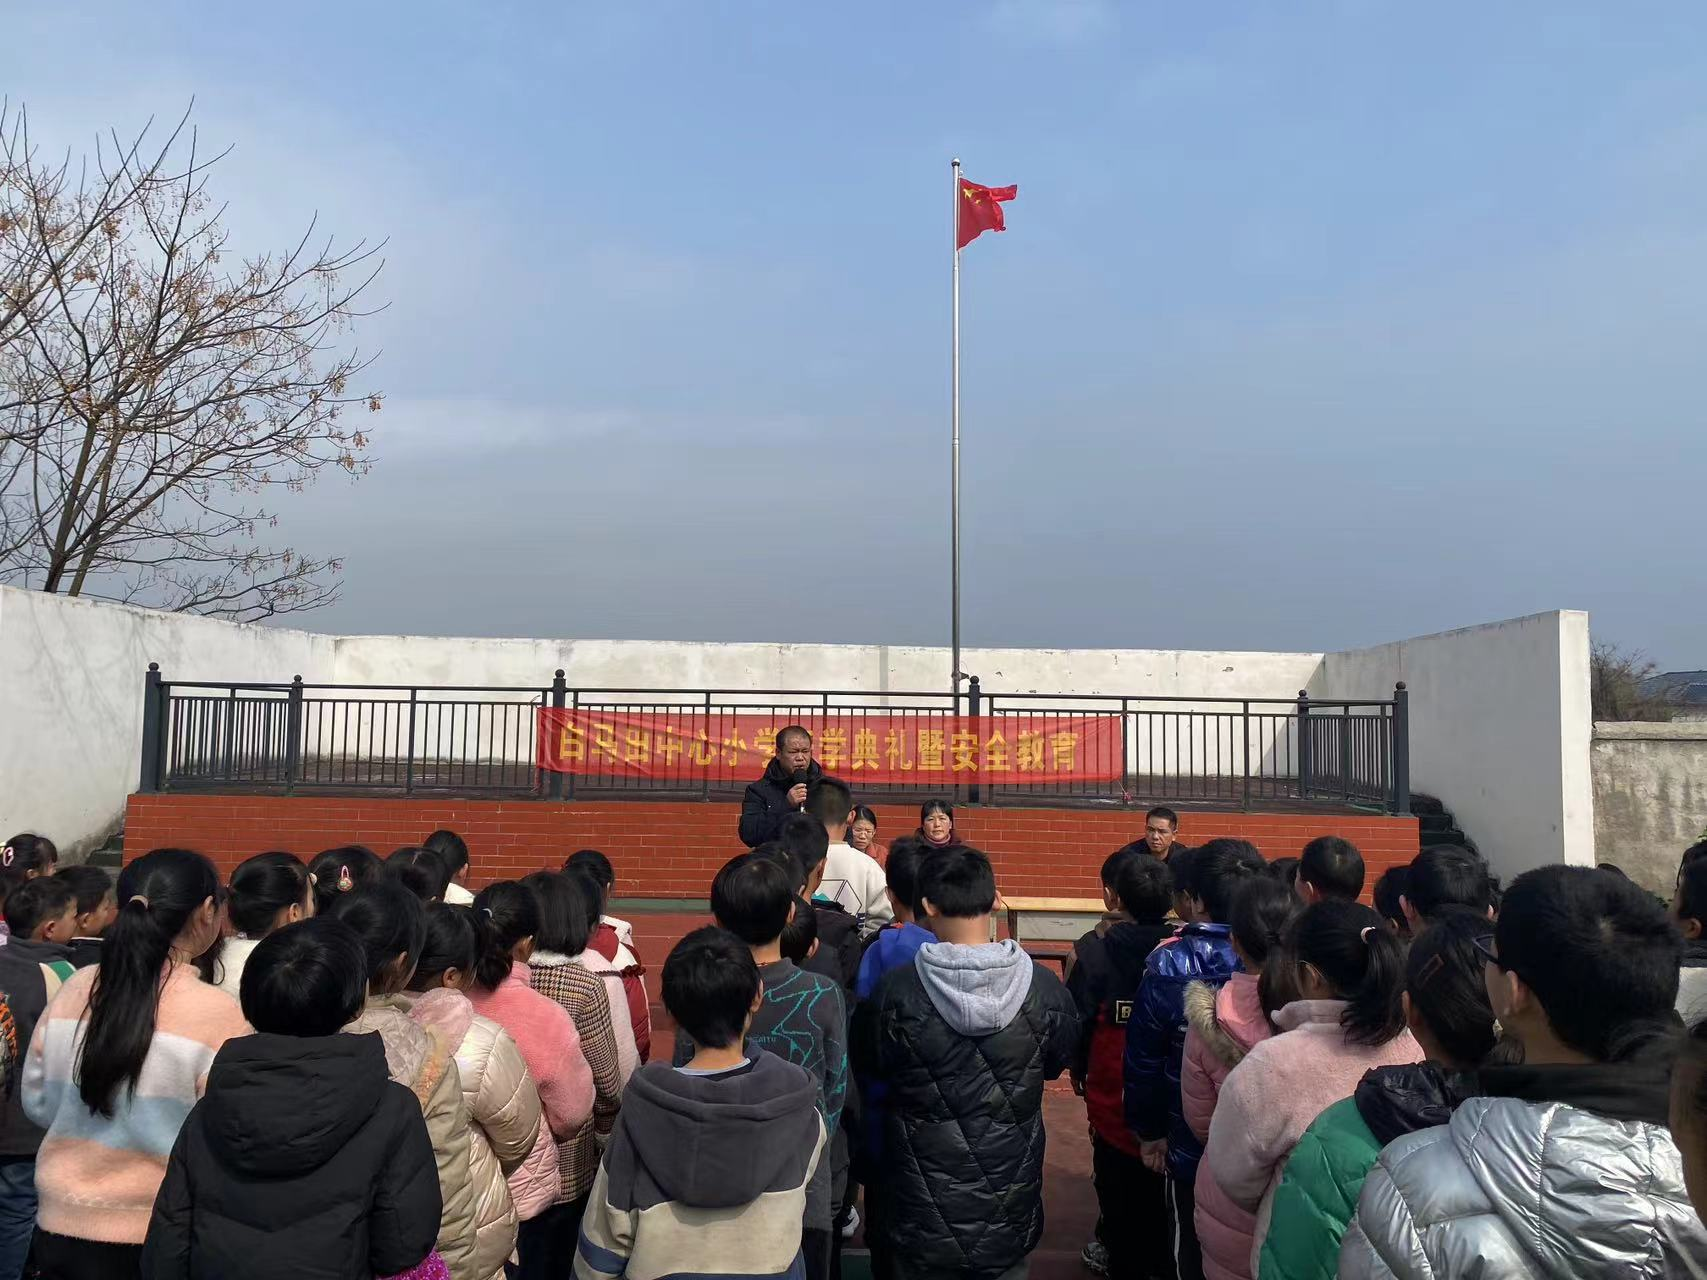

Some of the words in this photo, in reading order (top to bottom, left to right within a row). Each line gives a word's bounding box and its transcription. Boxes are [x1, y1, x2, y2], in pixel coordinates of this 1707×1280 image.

[559, 720, 1079, 772] 白马田中心小学学典礼暨安全教育
